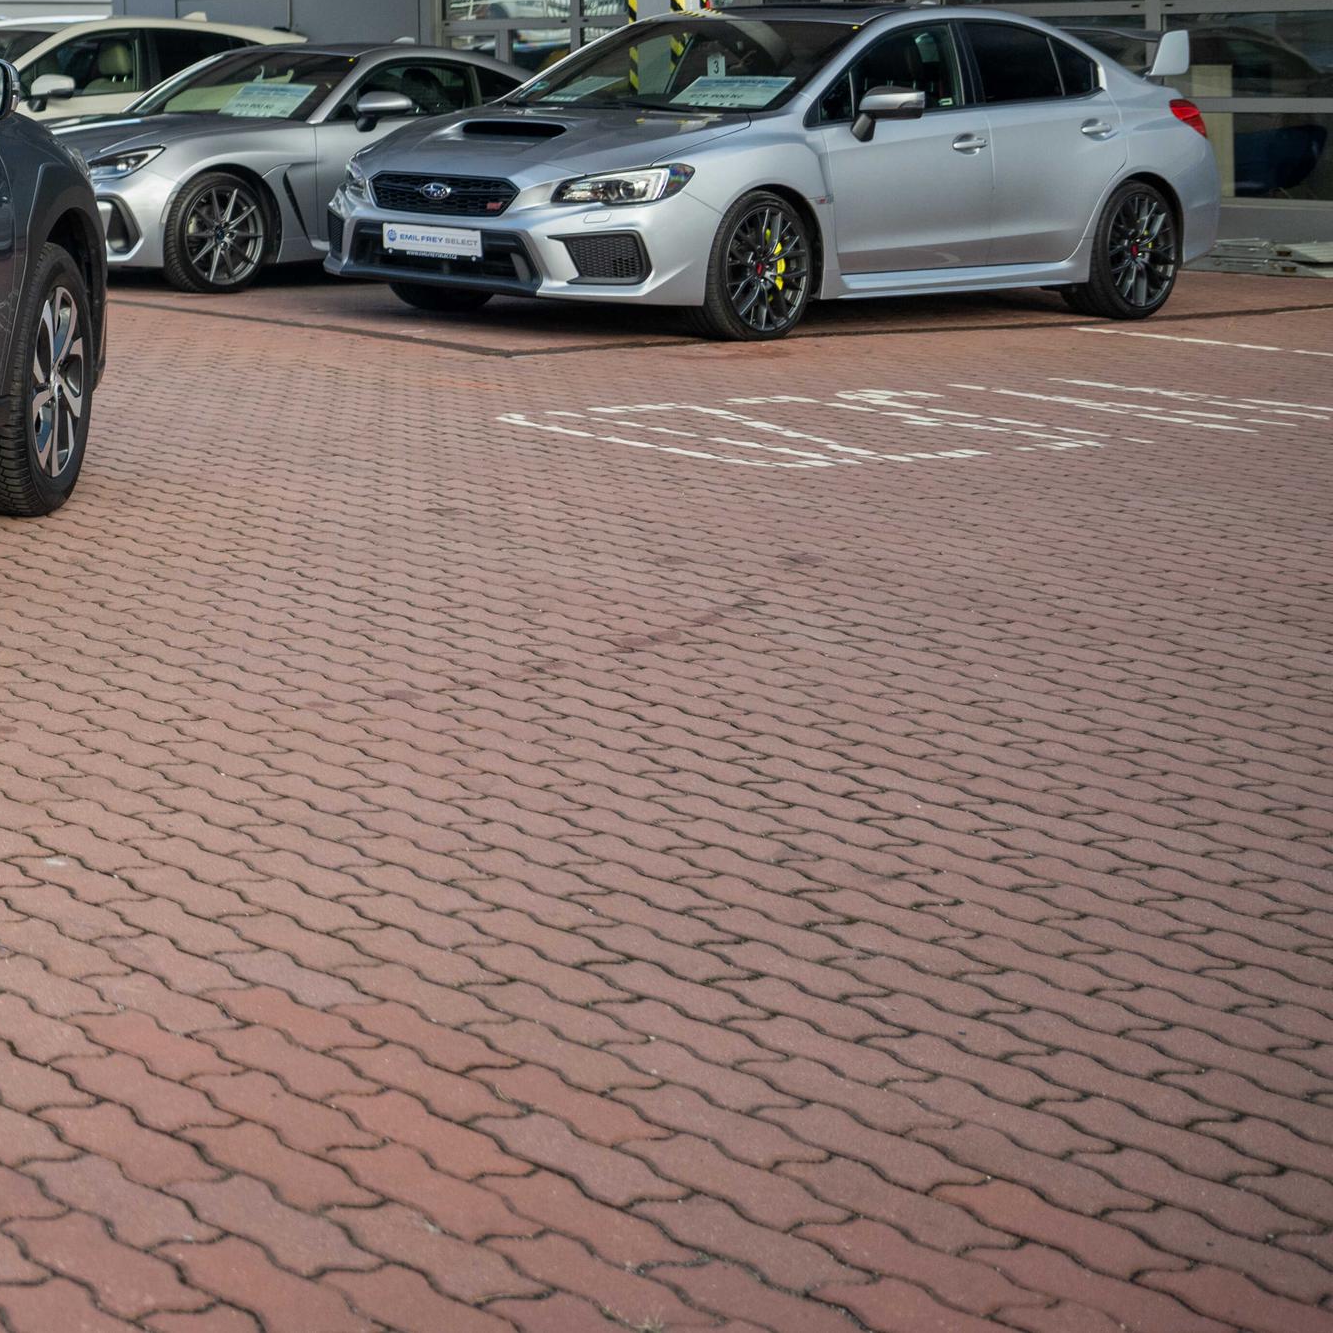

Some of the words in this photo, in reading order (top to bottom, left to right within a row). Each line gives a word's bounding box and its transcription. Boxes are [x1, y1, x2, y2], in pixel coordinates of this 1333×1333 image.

[712, 60, 720, 74] 3
[399, 232, 420, 242] EMIL
[420, 234, 444, 244] FREY
[444, 237, 479, 247] SELECT
